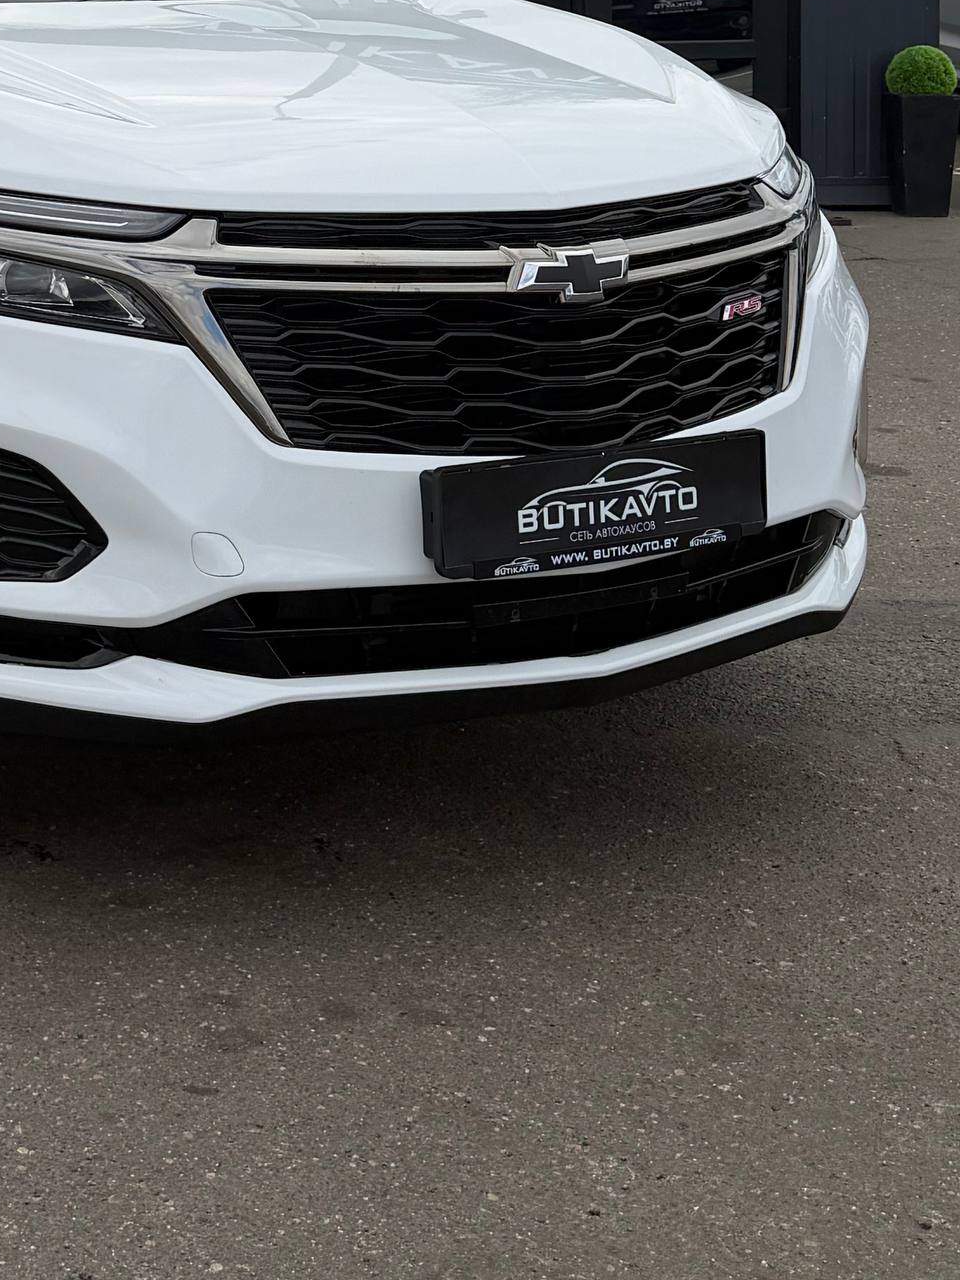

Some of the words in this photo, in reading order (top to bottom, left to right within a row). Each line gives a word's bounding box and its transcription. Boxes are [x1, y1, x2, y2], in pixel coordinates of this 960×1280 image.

[722, 295, 762, 321] RS
[517, 486, 698, 534] BUTIKAVTO
[569, 528, 594, 543] СЕТЬ
[595, 520, 657, 540] АВТОХАУСОВ
[689, 534, 727, 548] BUTIKAVTO
[551, 550, 589, 566] WWW.
[593, 536, 679, 561] BUTIKAVTO.BY
[494, 563, 540, 577] BUTIKAVTO
